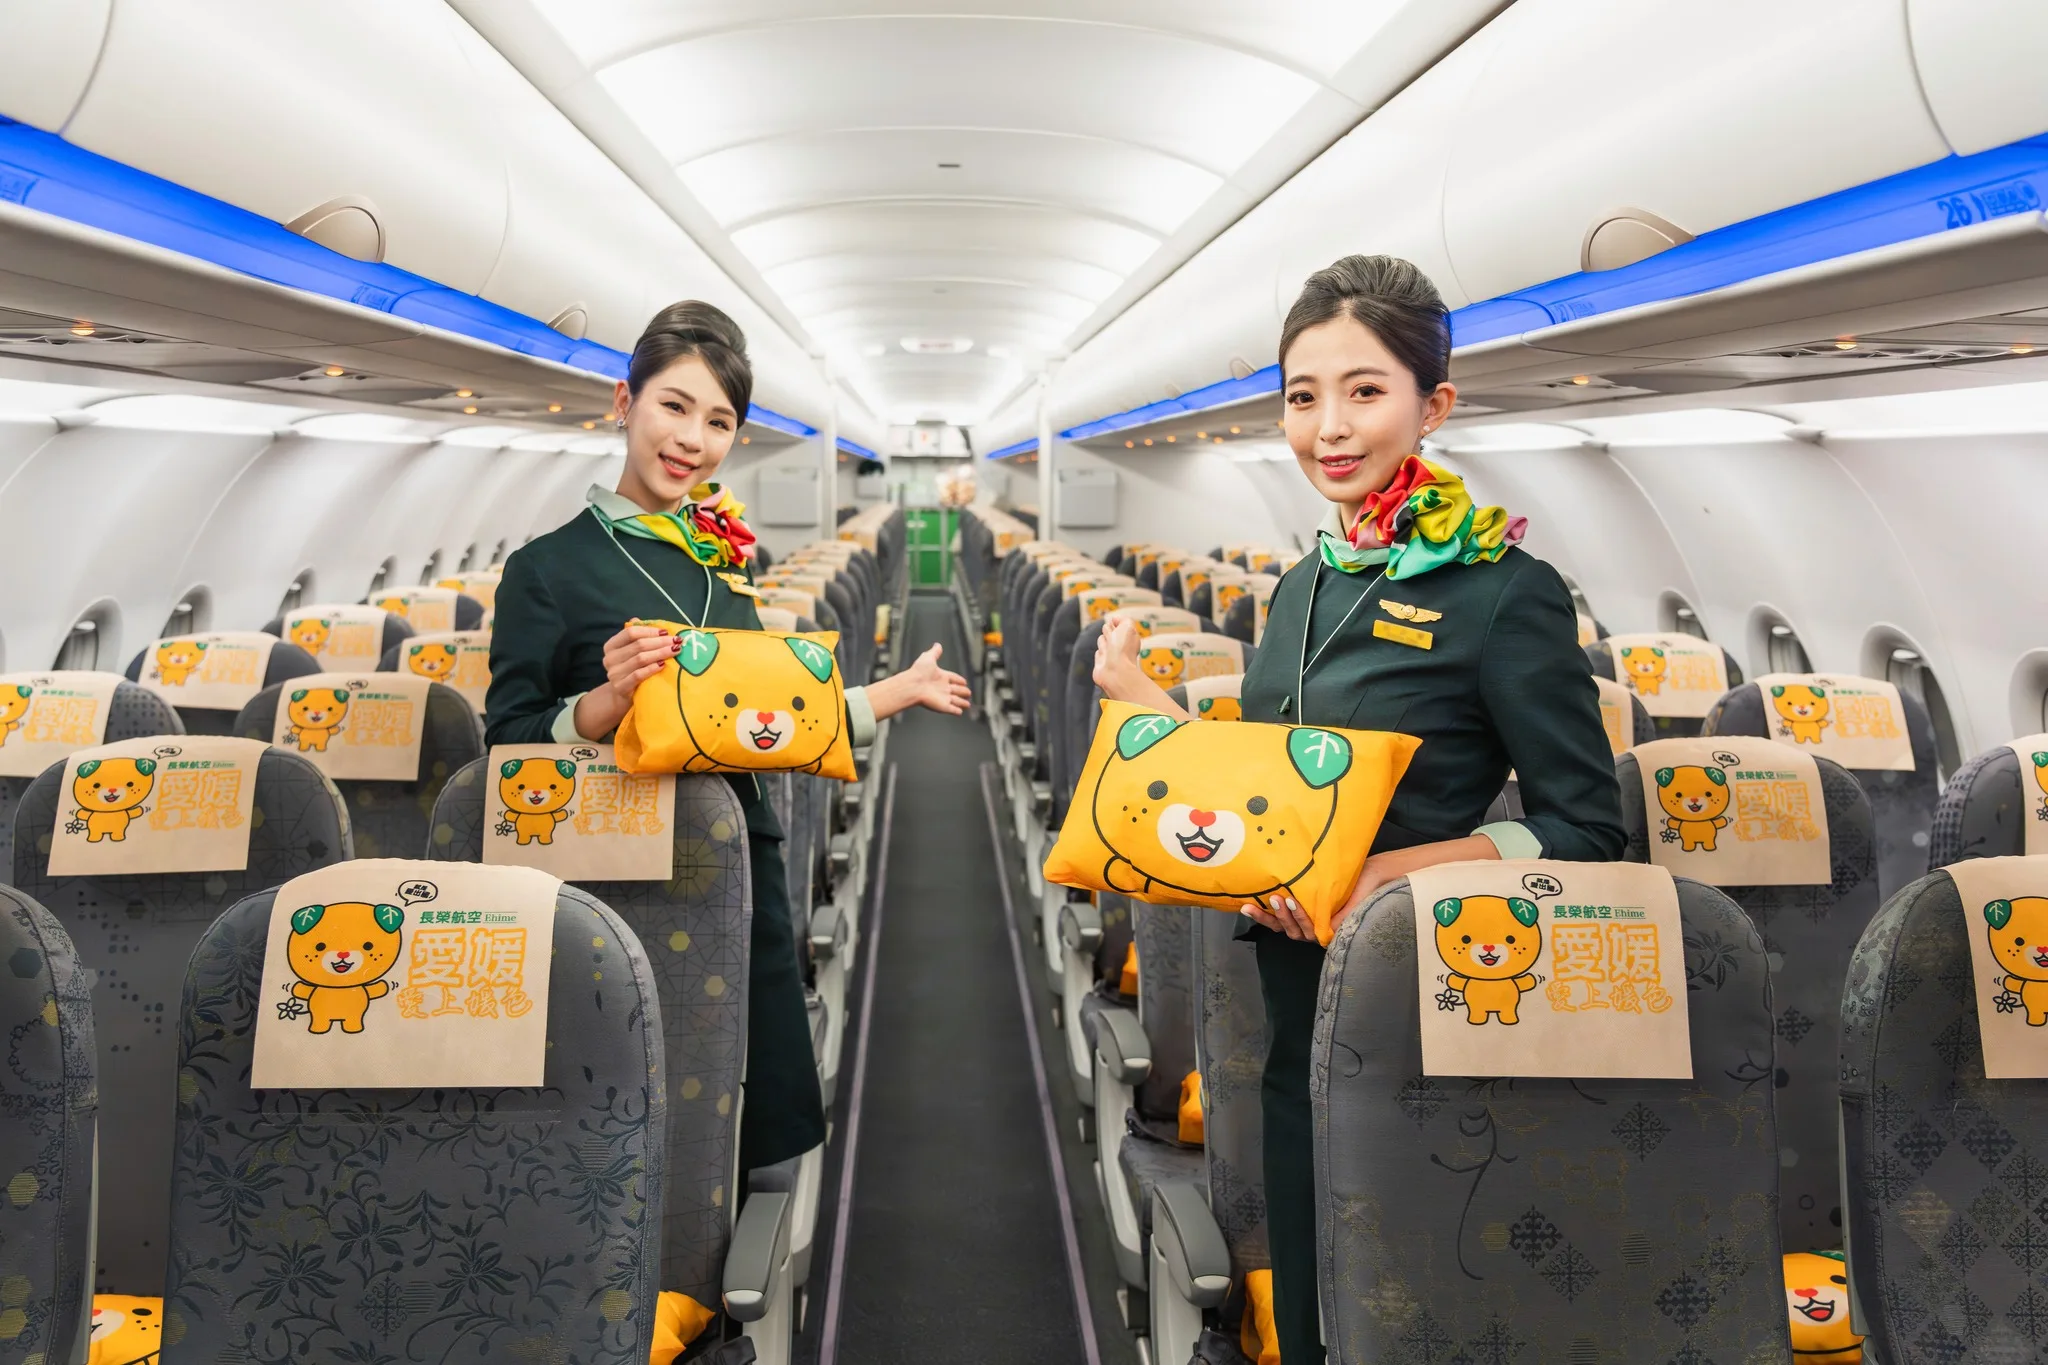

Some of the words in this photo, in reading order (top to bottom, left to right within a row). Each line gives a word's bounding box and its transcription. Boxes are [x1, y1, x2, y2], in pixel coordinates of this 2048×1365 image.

[1937, 196, 1973, 230] 26
[419, 911, 482, 924] 長榮航空
[484, 913, 517, 923] Ehime
[1553, 905, 1612, 919] 長榮航空
[1614, 908, 1645, 918] Ehime
[408, 927, 527, 988] 愛媛
[1551, 923, 1661, 983] 愛媛
